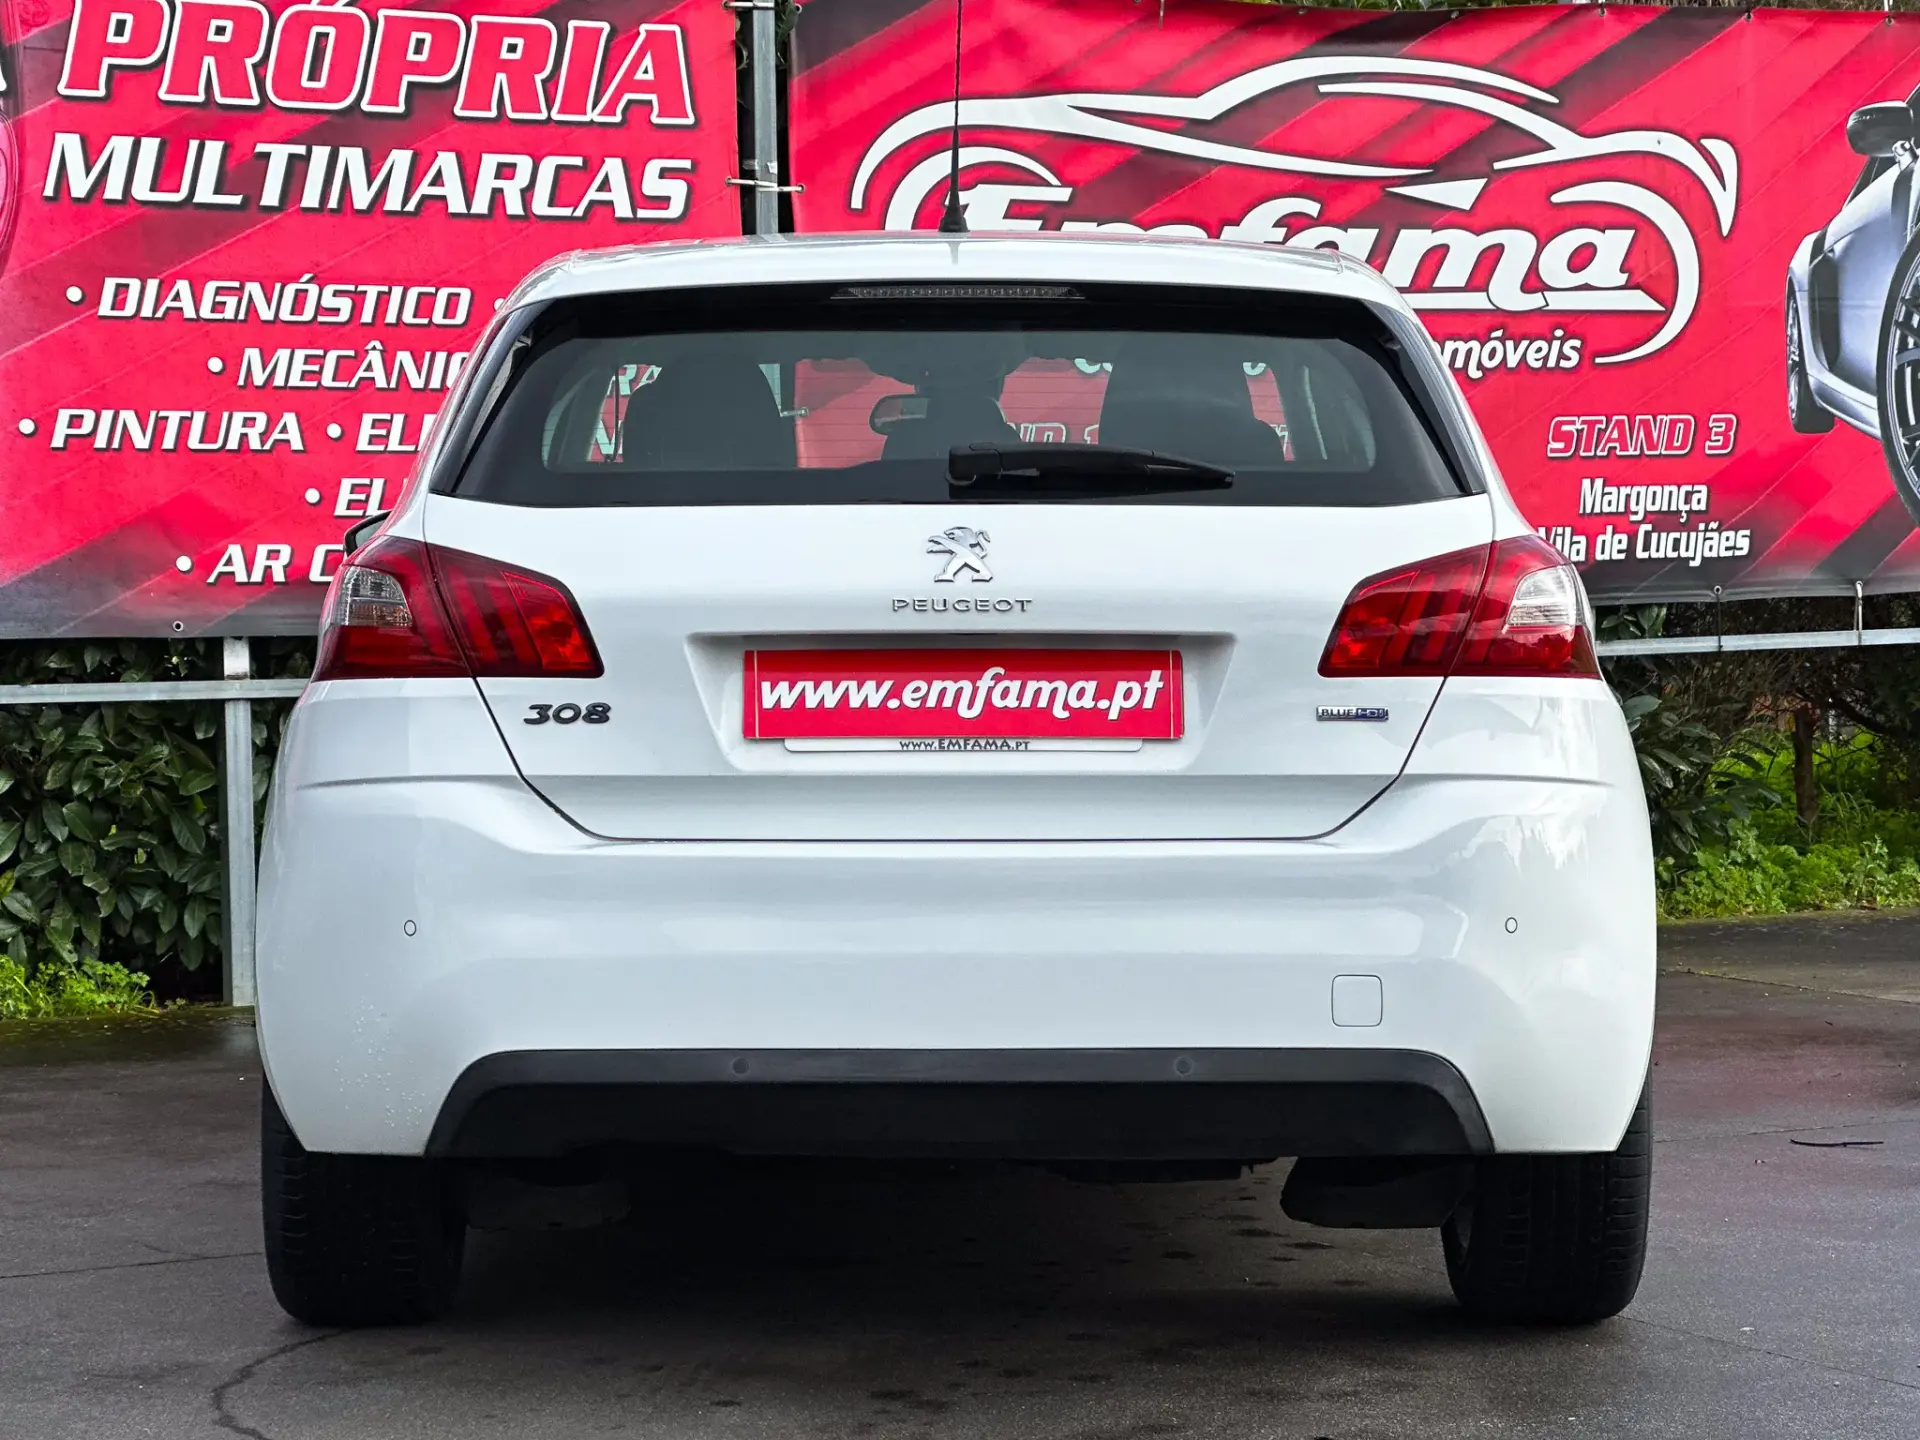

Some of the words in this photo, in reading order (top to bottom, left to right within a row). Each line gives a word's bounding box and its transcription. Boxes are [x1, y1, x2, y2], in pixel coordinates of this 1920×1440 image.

[43, 132, 692, 220] MULTIMARCAS
[97, 273, 472, 326] DIAGNÓSTICO
[1434, 329, 1582, 379] móveis
[50, 409, 304, 452] PINTURA
[1547, 414, 1695, 457] STAND
[1704, 414, 1737, 454] 3
[1579, 478, 1708, 522] Margonça
[206, 544, 291, 583] AR
[1595, 525, 1627, 561] de
[1635, 522, 1751, 567] Cucujães
[892, 597, 1033, 612] PEUGEOT
[523, 702, 611, 725] 308
[760, 667, 1163, 720] www.emfama.pt
